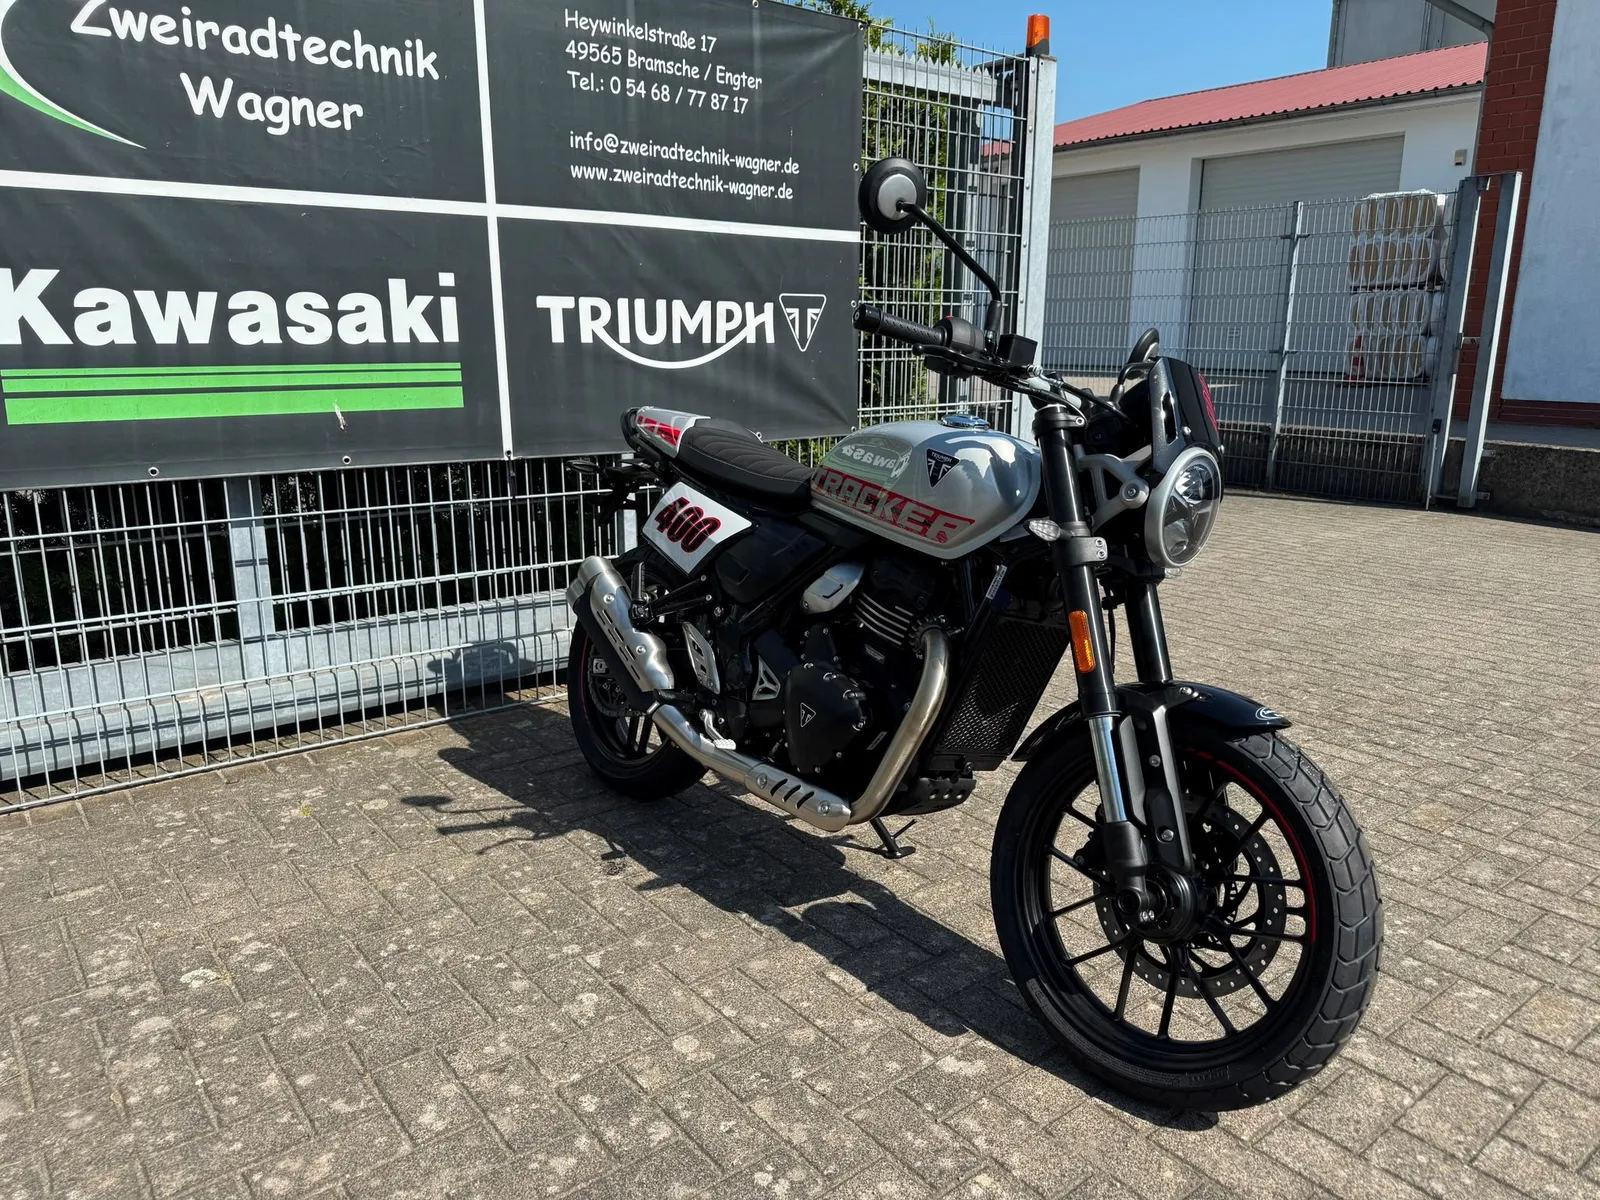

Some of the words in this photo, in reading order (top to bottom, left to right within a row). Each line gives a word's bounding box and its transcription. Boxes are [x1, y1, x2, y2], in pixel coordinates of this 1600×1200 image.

[70, 0, 440, 80] Zweiradtechnik
[564, 8, 696, 50] Heywinkelstraße
[700, 35, 717, 53] 17
[565, 39, 622, 65] 49565
[628, 49, 700, 79] Bramsche
[704, 63, 712, 81] /
[716, 65, 762, 90] Engter
[567, 70, 604, 93] Tel.:
[609, 76, 621, 95] 0
[626, 80, 646, 99] 54
[650, 84, 670, 103] 68
[674, 87, 683, 104] /
[687, 88, 706, 108] 77
[710, 92, 729, 111] 87
[733, 97, 748, 115] 17
[179, 72, 364, 136] Wagner
[569, 131, 800, 175] info@zweiradtechnik-wagner.de
[570, 163, 794, 200] www.zweiradtechnik-wagner.de
[0, 267, 460, 346] Kawasaki
[536, 295, 776, 369] TRIUMPH
[654, 497, 721, 553] 400
[812, 468, 971, 543] TRACKER
